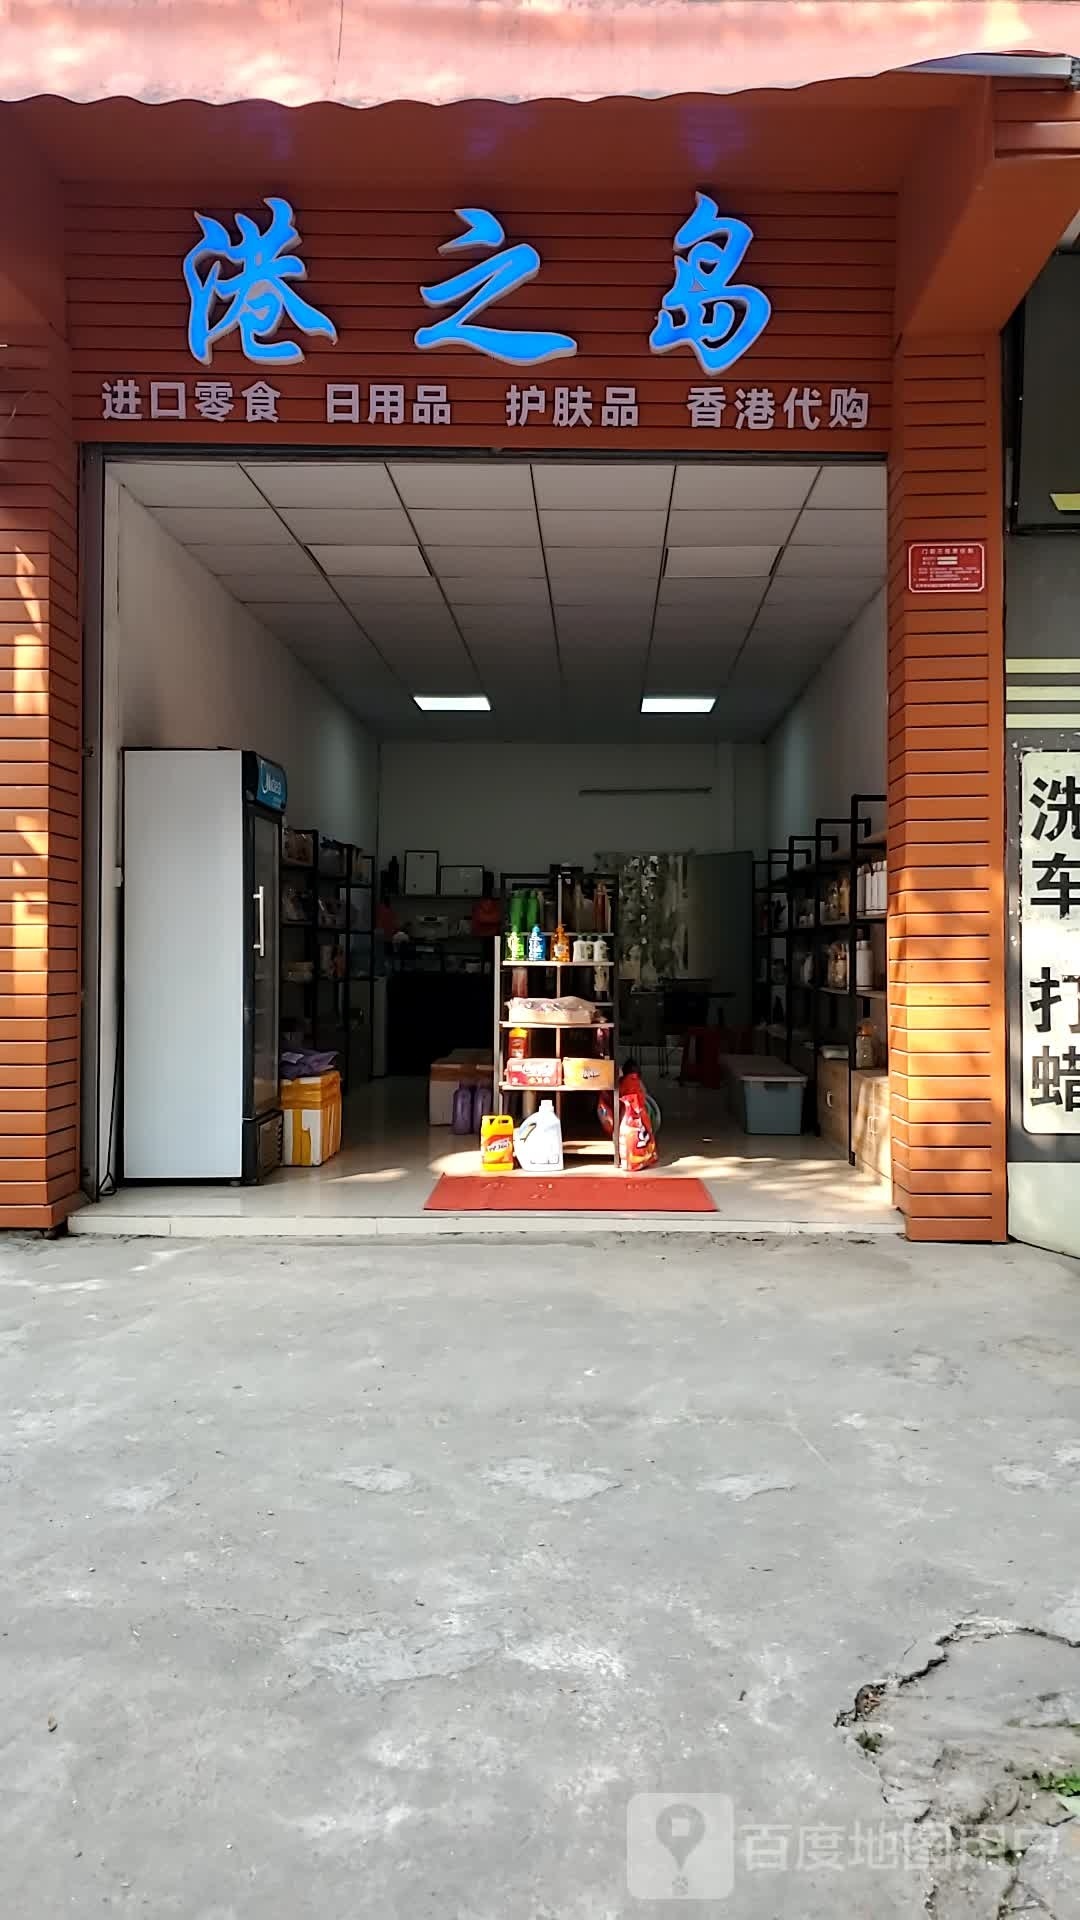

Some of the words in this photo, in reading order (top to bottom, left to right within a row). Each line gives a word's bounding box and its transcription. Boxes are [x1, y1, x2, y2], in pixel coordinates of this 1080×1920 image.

[183, 192, 773, 376] 港之岛
[101, 379, 282, 424] 进口零食
[326, 383, 452, 425] 日用品
[505, 385, 639, 428] 护肤品
[687, 386, 869, 430] 香港代购
[1029, 775, 1080, 920] 洗车
[1030, 966, 1080, 1113] 打蜡
